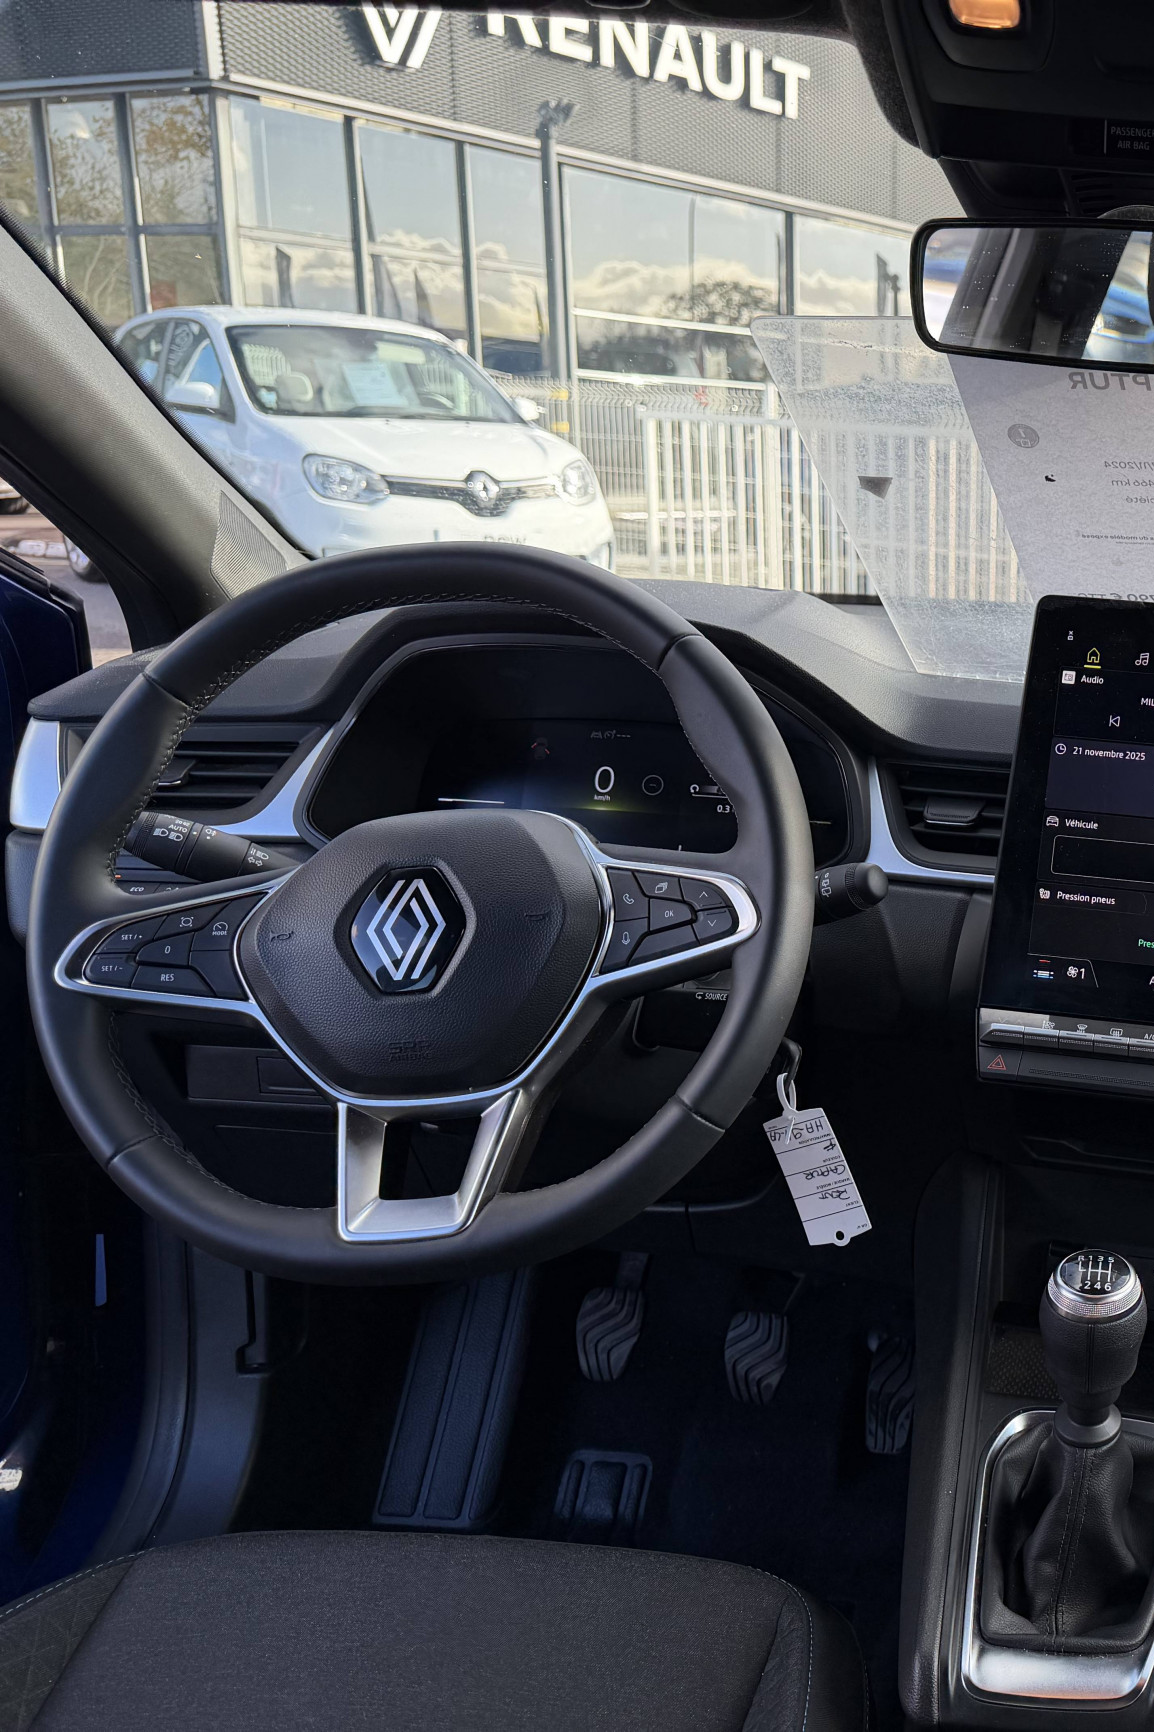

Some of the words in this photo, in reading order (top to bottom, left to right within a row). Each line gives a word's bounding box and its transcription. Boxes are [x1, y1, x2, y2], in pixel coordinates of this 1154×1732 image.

[1117, 141, 1131, 149] AIR
[1133, 141, 1150, 150] BAG
[1080, 674, 1104, 685] Audio
[1072, 746, 1083, 756] 21
[1085, 747, 1124, 759] novembre
[1125, 750, 1146, 761] 2025
[594, 766, 615, 793] 0
[594, 794, 611, 802] km/h
[168, 824, 188, 833] AUTO
[1065, 818, 1099, 830] Véhicule
[1056, 891, 1092, 904] Pression
[1092, 896, 1116, 907] pneus
[664, 910, 674, 918] OK
[121, 933, 134, 941] SET
[160, 973, 174, 982] RES
[705, 992, 728, 1001] SOURCE
[803, 1164, 846, 1181] CAPTUR
[1084, 1281, 1091, 1290] 2
[1094, 1282, 1101, 1290] 4
[1105, 1283, 1112, 1291] 6
